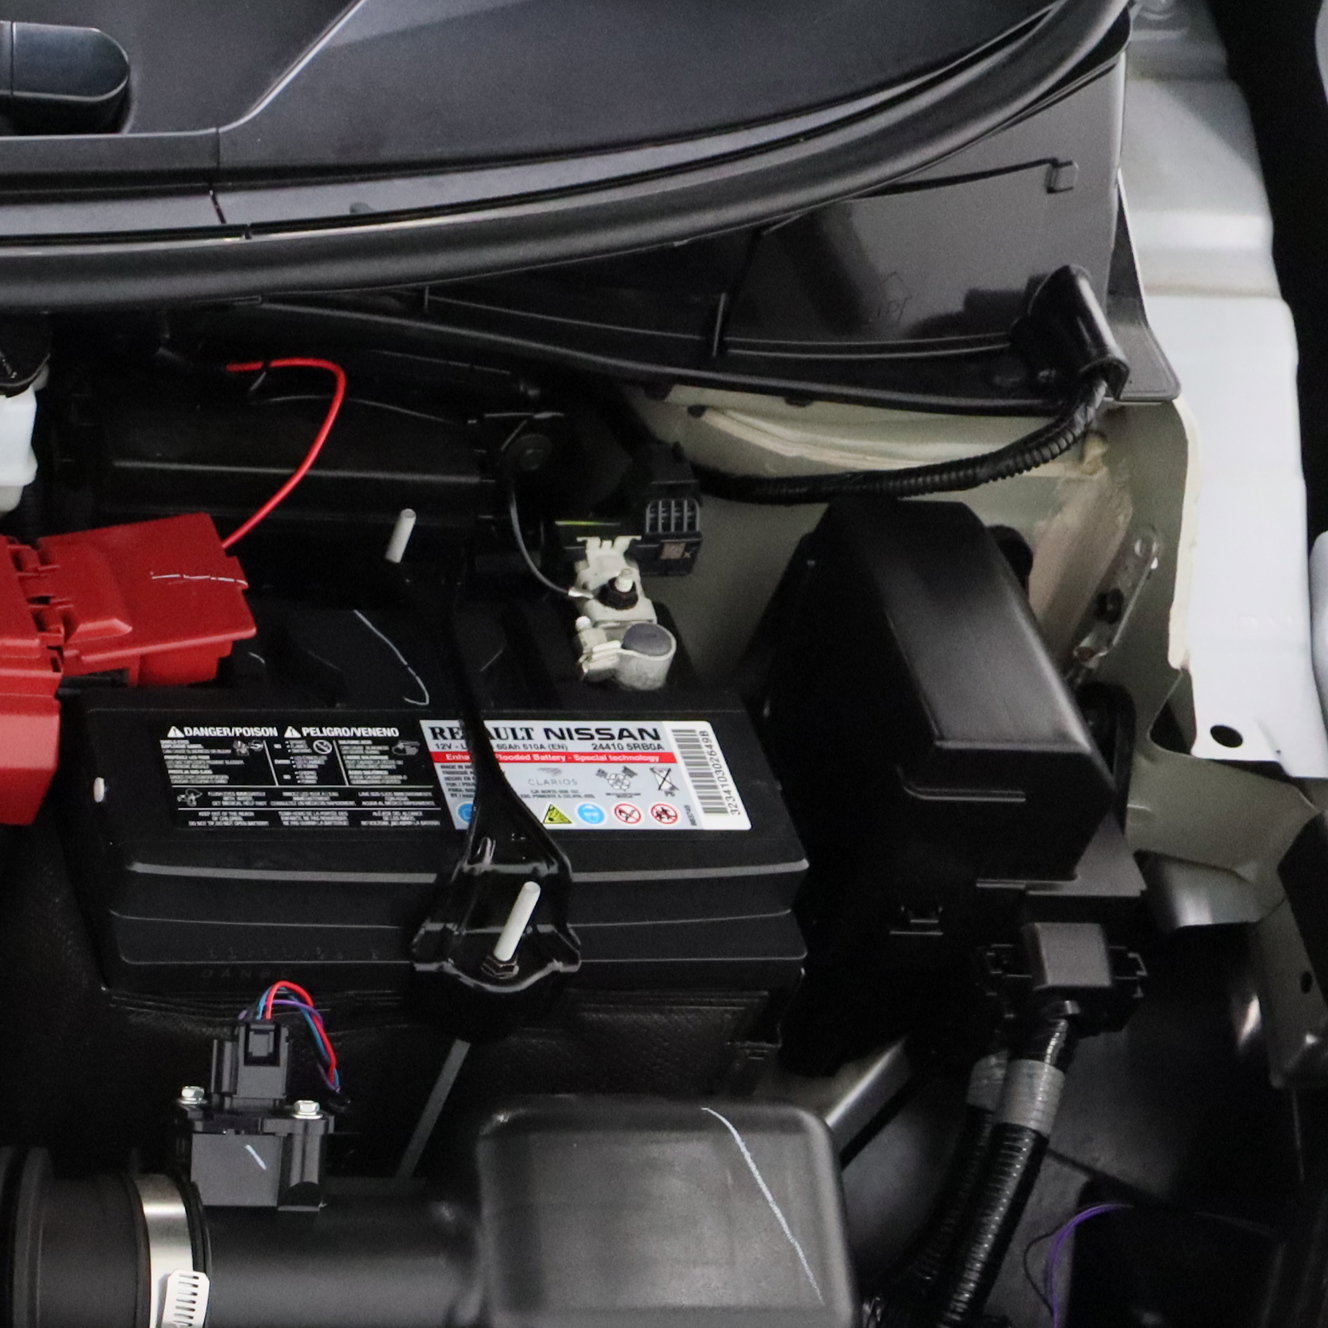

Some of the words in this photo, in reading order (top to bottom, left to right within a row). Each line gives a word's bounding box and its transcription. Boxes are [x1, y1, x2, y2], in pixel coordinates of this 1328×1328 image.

[183, 726, 279, 737] DANGER/POISON
[301, 726, 400, 737] PELIGRO/VENENO
[428, 726, 534, 741] REULT
[543, 727, 661, 741] NISSAN
[592, 743, 624, 751] 24410
[533, 754, 566, 762] Battery
[574, 754, 607, 763] Special
[609, 754, 660, 763] technology
[528, 778, 578, 786] CLARIOS
